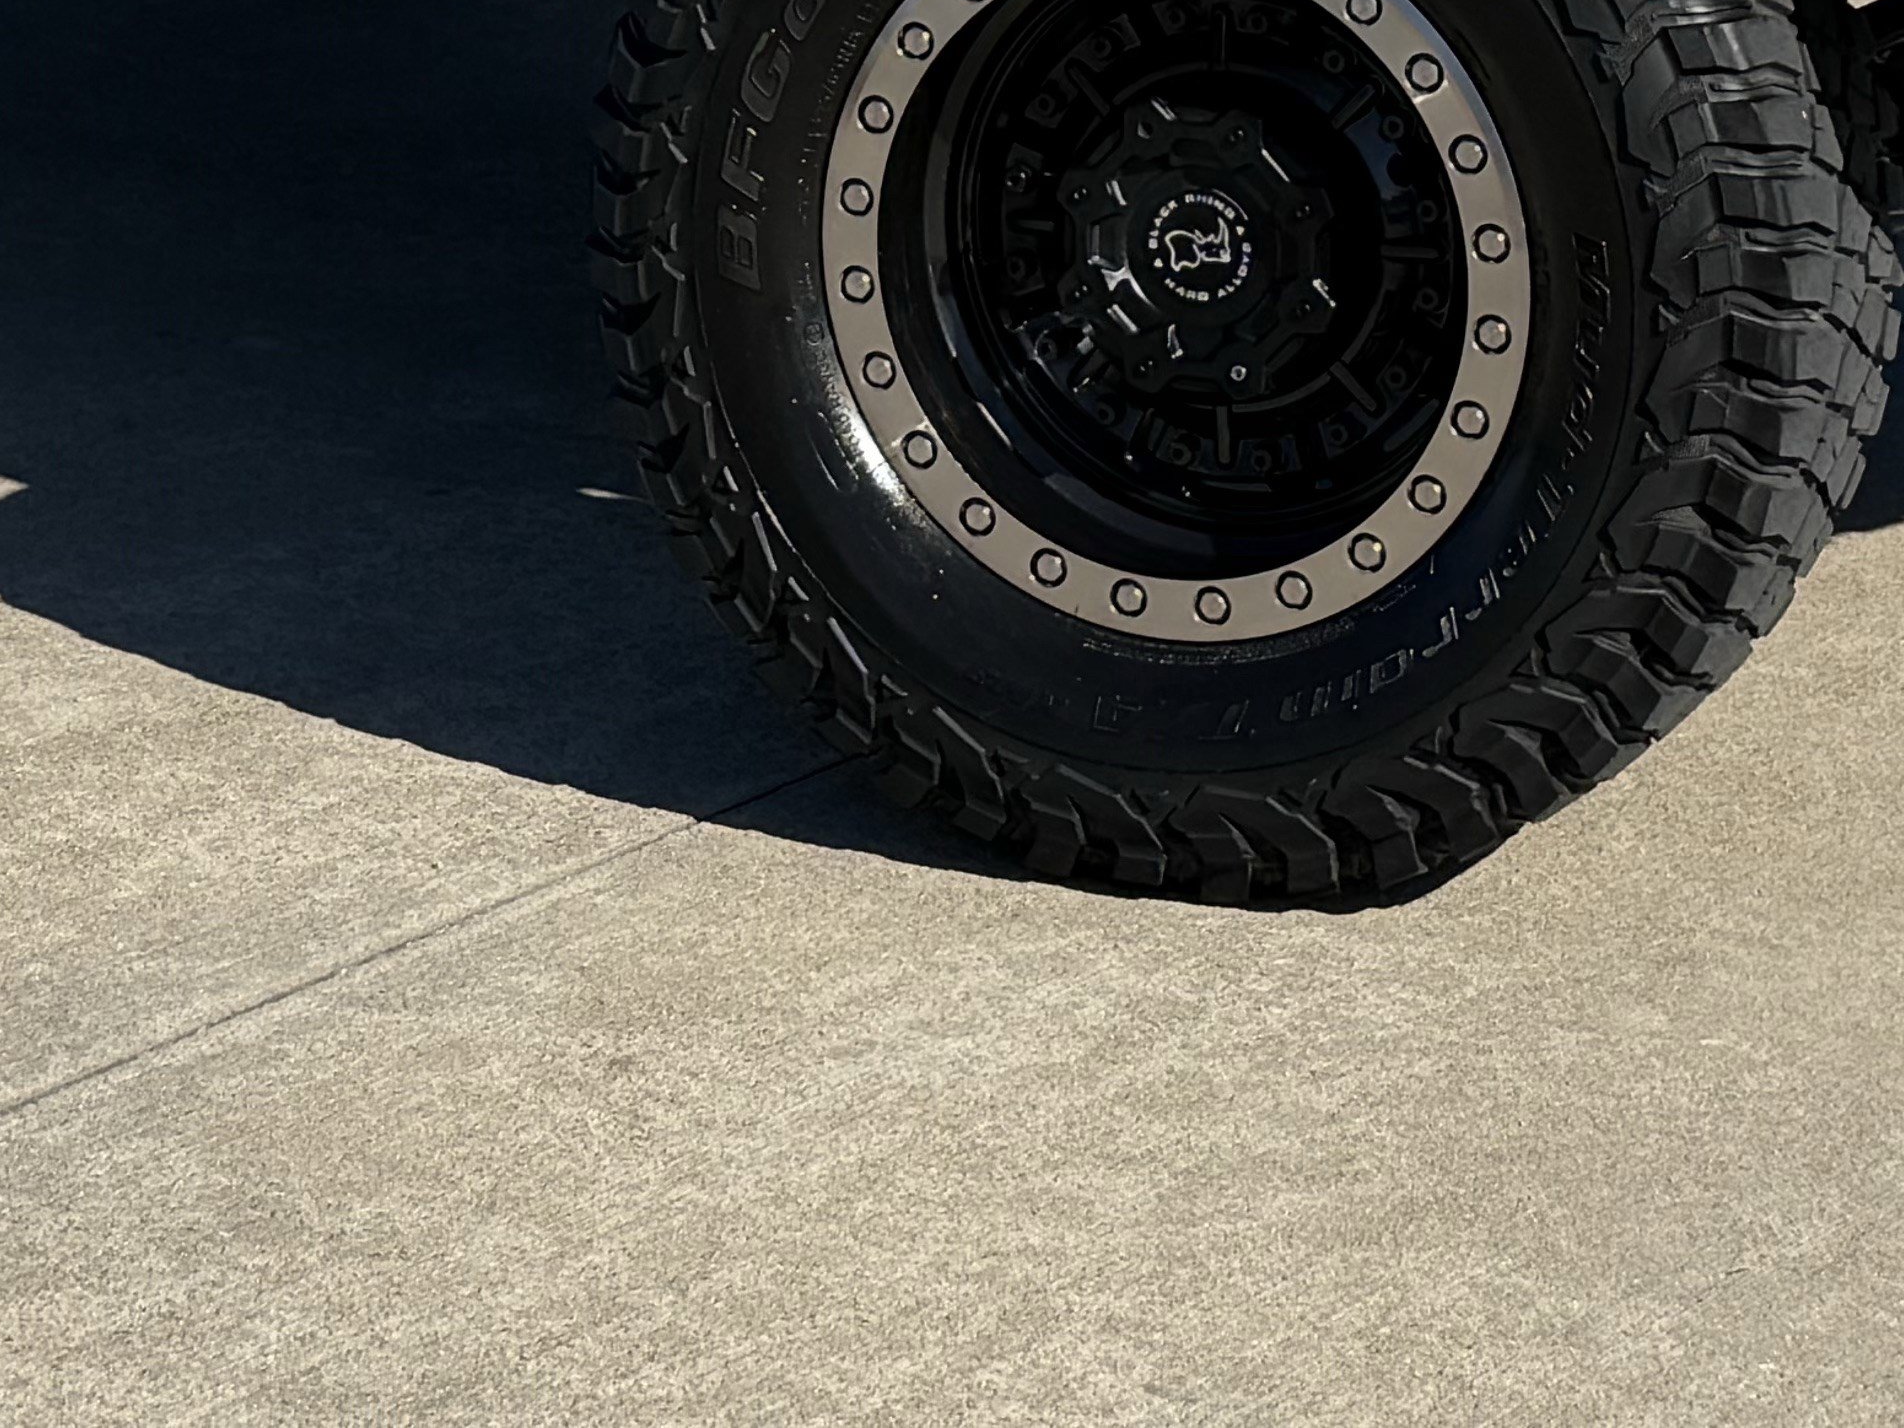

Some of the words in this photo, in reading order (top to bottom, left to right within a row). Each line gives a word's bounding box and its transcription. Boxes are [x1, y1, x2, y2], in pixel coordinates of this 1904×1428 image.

[1148, 199, 1178, 250] BLACK
[1184, 193, 1236, 221] RHINO
[1277, 231, 1612, 724] Mud-Terrain
